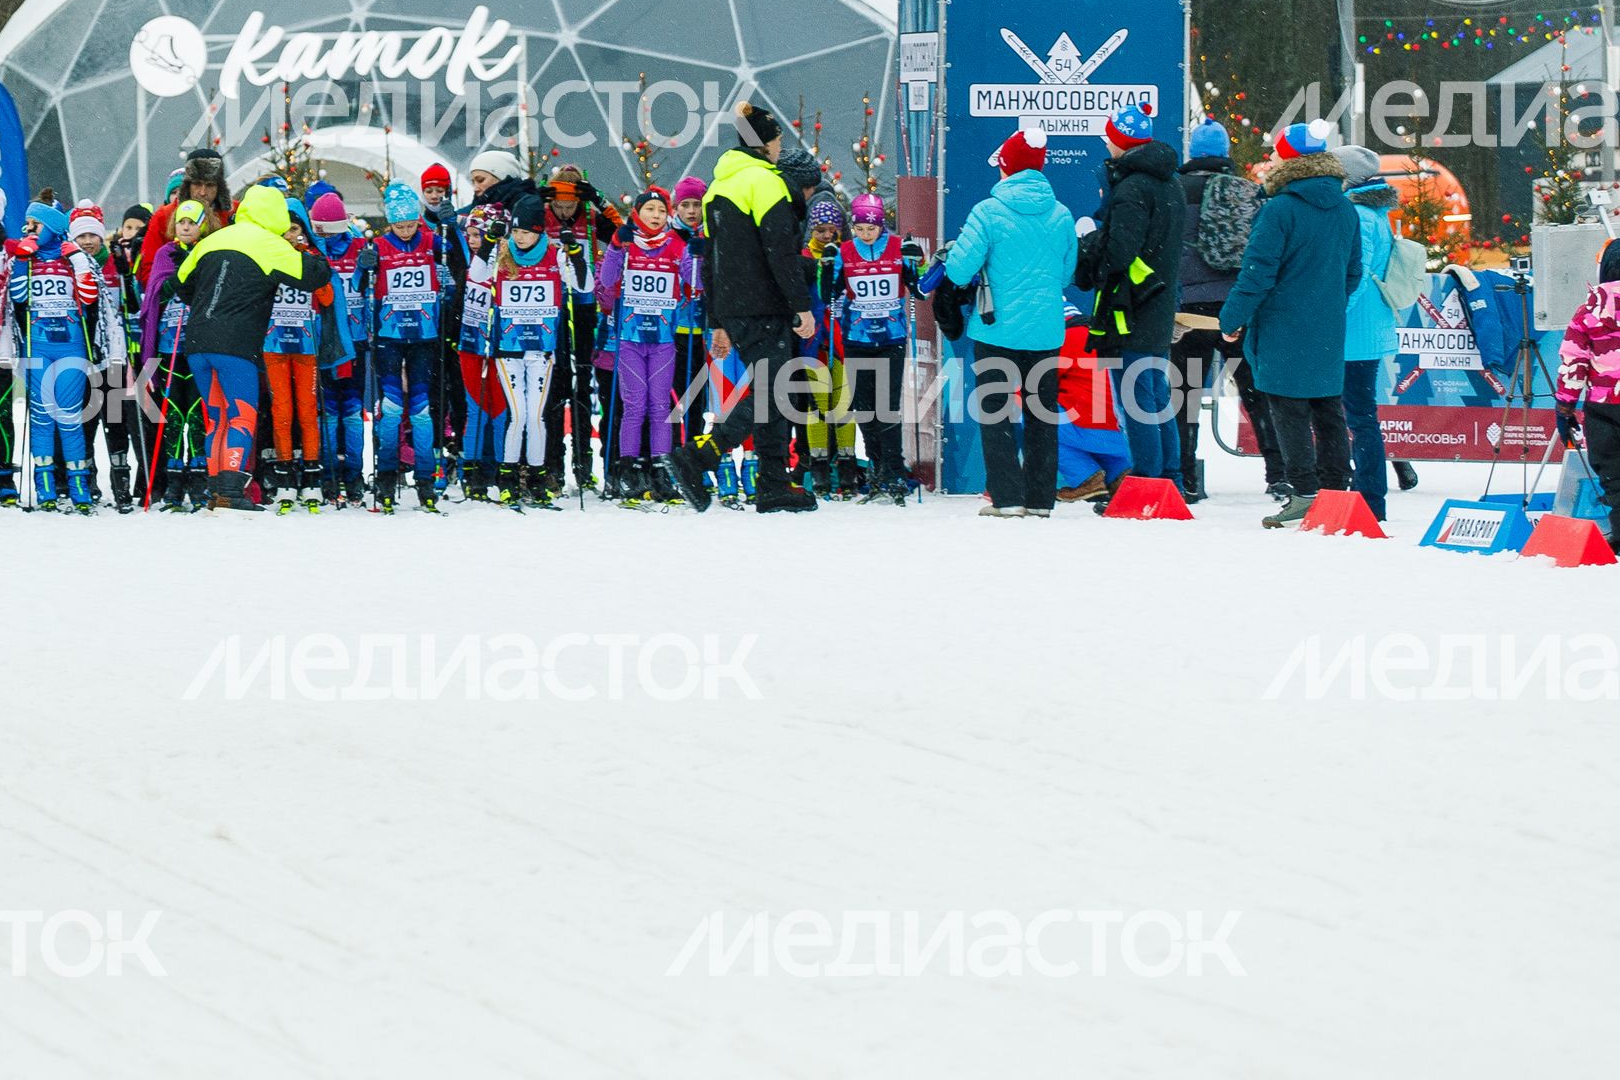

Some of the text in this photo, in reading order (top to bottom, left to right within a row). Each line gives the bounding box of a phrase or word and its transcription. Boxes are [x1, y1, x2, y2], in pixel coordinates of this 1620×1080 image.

[1055, 59, 1072, 72] 54
[1038, 119, 1089, 133] ЛЫЖНЯ
[1045, 149, 1088, 157] СНОВАНА
[31, 278, 67, 297] 928
[392, 270, 425, 288] 929
[631, 275, 667, 294] 980
[856, 279, 891, 297] 919
[465, 285, 488, 308] 44
[509, 285, 546, 303] 973
[1446, 308, 1460, 319] 54
[1397, 332, 1477, 351] АНЖОСОВ
[1433, 356, 1471, 367] ЛЫЖНЯ
[1471, 519, 1500, 539] SPORT
